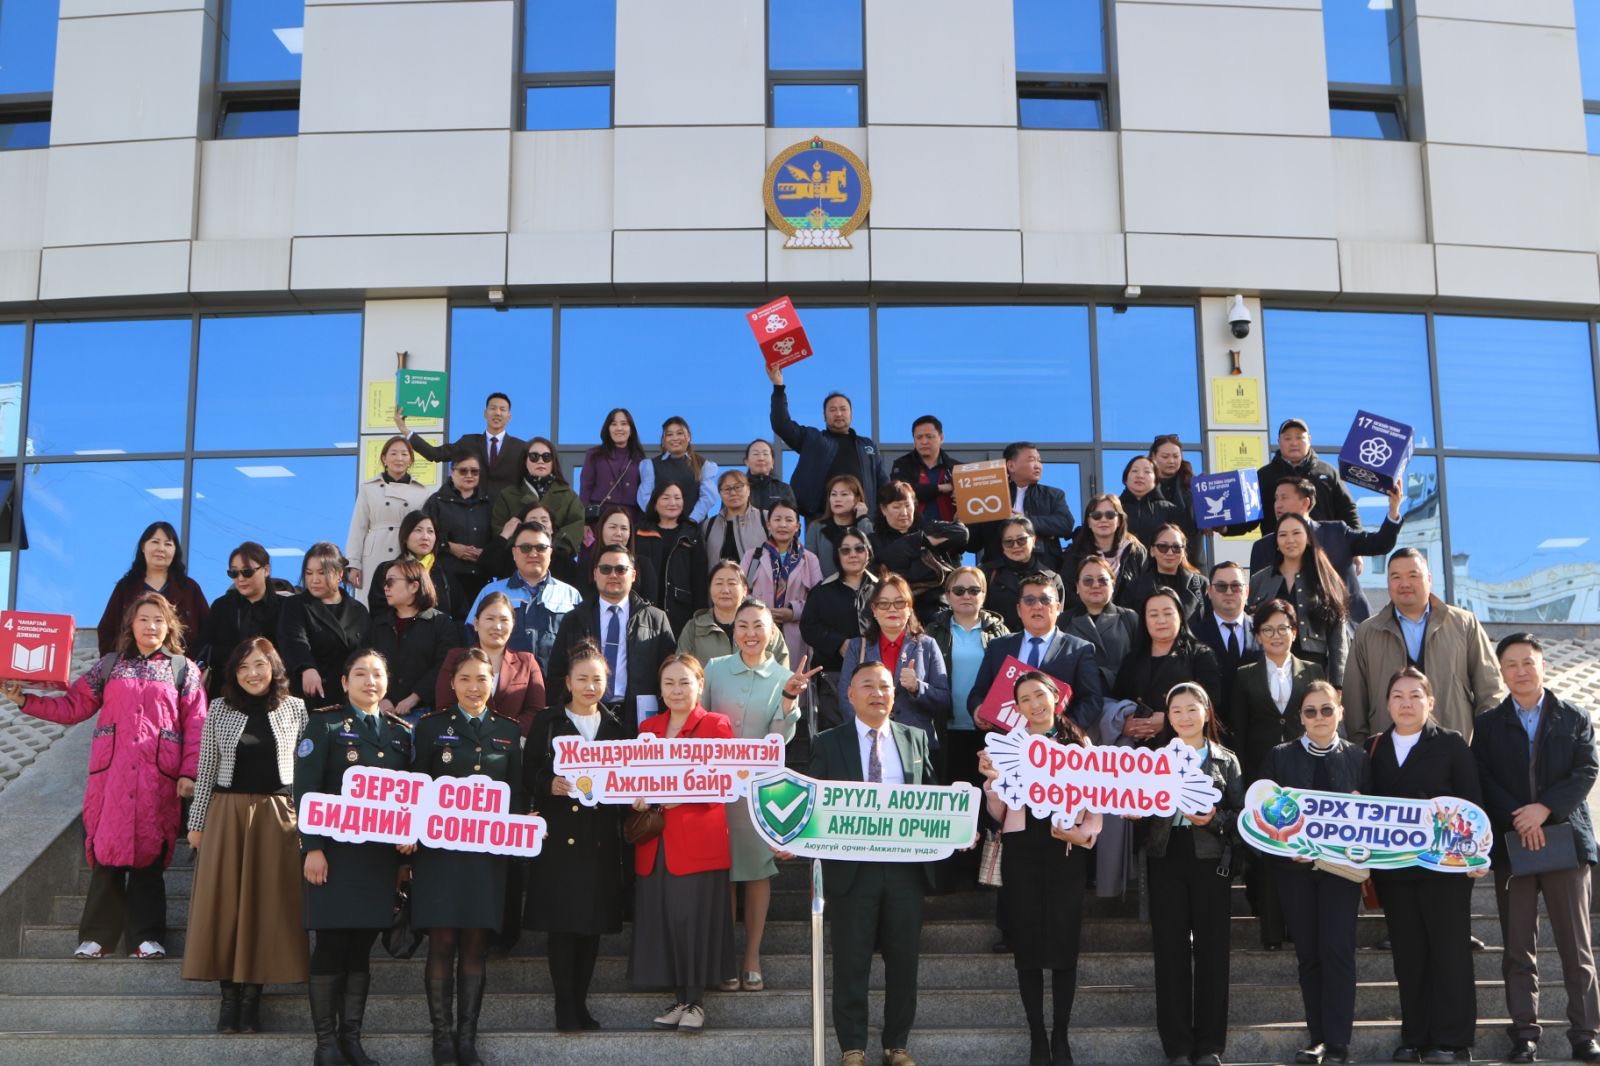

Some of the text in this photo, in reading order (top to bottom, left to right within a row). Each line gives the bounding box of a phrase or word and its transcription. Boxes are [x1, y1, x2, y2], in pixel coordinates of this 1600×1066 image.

[404, 374, 410, 384] 3
[1358, 416, 1373, 429] 17
[958, 477, 971, 488] 12
[1195, 481, 1208, 493] 16
[4, 618, 13, 630] 4
[1006, 665, 1017, 679] 8
[558, 738, 779, 767] Жендэрийн мэдрэмжтэй
[1028, 740, 1171, 778] Оролцоод
[350, 773, 502, 814] ЭЕРЭГ СОЁЛ
[605, 768, 732, 797] Ажлын байр
[822, 786, 969, 812] ЭРҮҮЛ, АЮУЛГҮЙ
[1028, 782, 1170, 814] өөрчилье
[1302, 798, 1422, 824] ЭРХ ТЭГШ
[307, 801, 538, 849] БИДНИЙ СОНГОЛТ
[827, 815, 951, 839] АЖЛЫН ОРЧИН
[1305, 821, 1427, 848] ОРОЛЦОО
[804, 841, 839, 852] Аюулгүй
